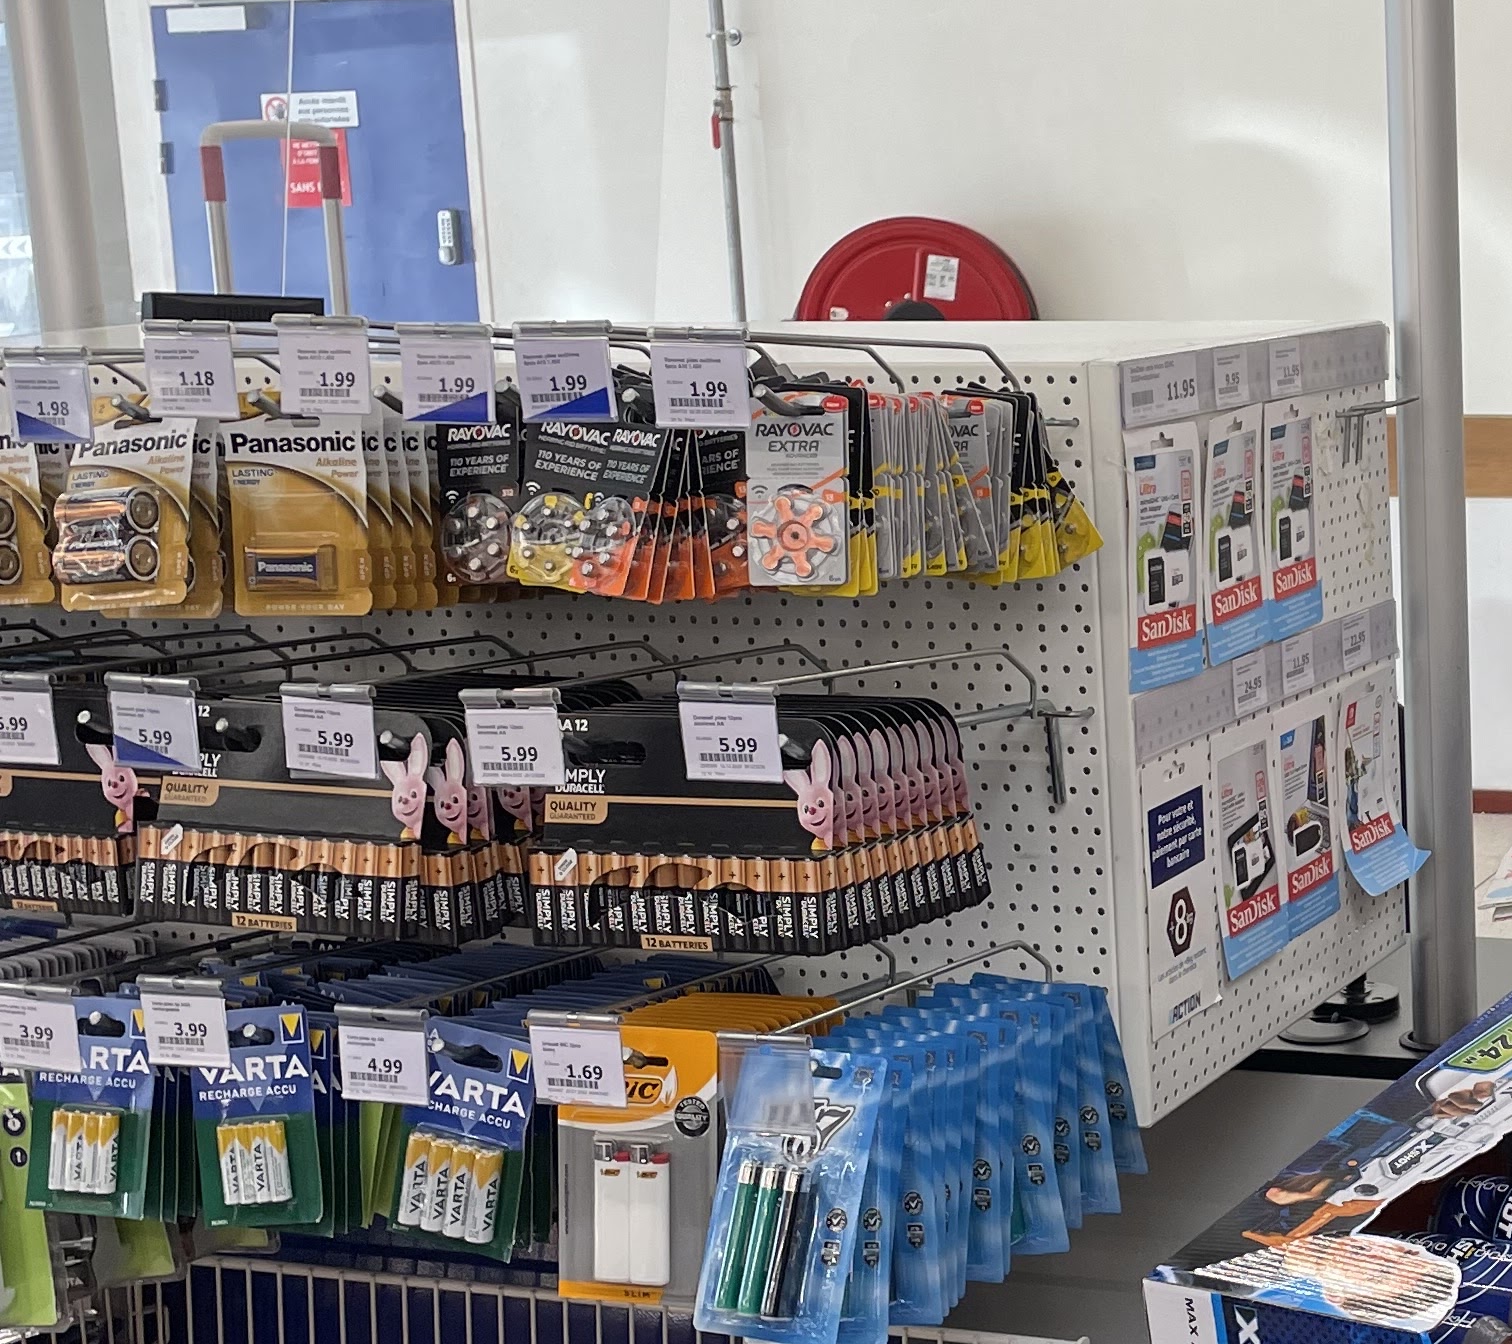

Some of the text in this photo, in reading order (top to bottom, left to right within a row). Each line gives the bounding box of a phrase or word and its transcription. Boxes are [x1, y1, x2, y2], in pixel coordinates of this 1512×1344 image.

[290, 181, 316, 193] SANS
[179, 371, 215, 386] 1.18
[1225, 371, 1240, 386] 9.95
[1283, 363, 1300, 378] 11.95
[320, 372, 356, 387] 1.99
[438, 377, 475, 392] 1.99
[549, 374, 588, 391] 1.99
[690, 381, 728, 397] 1.99
[1167, 378, 1196, 401] 11.95
[37, 401, 70, 416] 1.98
[447, 423, 511, 442] RAYOVAC
[541, 422, 611, 446] RAYOVAC
[612, 428, 661, 448] RAYOVAC
[756, 422, 834, 437] RAYOVAC
[78, 431, 189, 459] Panasonic
[230, 431, 357, 454] Panasonic
[768, 440, 820, 452] EXTRA
[315, 457, 357, 467] Alkaline
[465, 456, 492, 467] YEARS
[494, 453, 509, 465] OF
[555, 452, 586, 468] YEARS
[587, 459, 602, 471] OF
[618, 460, 639, 472] YEARS
[640, 462, 652, 473] OF
[71, 470, 109, 481] LASTING
[232, 468, 275, 479] LASTING
[331, 469, 359, 479] Power
[449, 464, 508, 477] EXPERIENCE
[534, 459, 599, 482] EXPERIENCE
[602, 468, 648, 485] EXPERIENCE
[257, 561, 314, 574] Panasonic
[1275, 562, 1314, 594] SanDisk
[1214, 583, 1259, 617] SanDisk
[1142, 611, 1193, 642] SanDisk
[1292, 652, 1310, 670] 11.95
[198, 705, 211, 718] 12
[574, 718, 589, 732] 12
[138, 728, 173, 746] 5.99
[317, 729, 354, 748] 5.99
[718, 737, 758, 753] 5.99
[501, 746, 538, 762] 5.99
[565, 768, 606, 784] MPLY
[166, 782, 209, 794] QUALITY
[555, 782, 605, 794] DURACELL
[550, 800, 597, 812] QUALITY
[549, 812, 596, 821] GUARANTEED
[1157, 811, 1172, 826] Pour
[1172, 804, 1186, 819] votre
[1156, 827, 1172, 842] notre
[1353, 816, 1392, 850] SanDisk
[1152, 826, 1203, 863] paiement par carte
[1166, 848, 1190, 869] bancaire
[167, 863, 177, 905] SIMPLY
[1291, 858, 1331, 895] SanDisk
[386, 880, 396, 923] SIMPLY
[542, 888, 552, 931] SIMPLY
[807, 896, 819, 940] SIMPLY
[1230, 893, 1277, 932] SanDisk
[236, 915, 294, 932] 12 BATTERIES
[645, 937, 709, 950] 12 BATTERIES
[1171, 990, 1202, 1025] ACTION
[19, 1024, 54, 1041] 3.99
[174, 1022, 207, 1038] 3.99
[81, 1044, 150, 1075] RTA
[367, 1058, 403, 1074] 4.99
[199, 1053, 310, 1085] VARTA
[566, 1064, 603, 1081] 1.69
[39, 1072, 137, 1089] RECHARGE ACCU
[199, 1084, 297, 1101] RECHARGE ACCU
[429, 1070, 526, 1119] VARTA
[680, 1097, 706, 1110] TESTED
[428, 1099, 511, 1129] CHARGE ACCU
[255, 1143, 266, 1193] VARTA
[432, 1167, 450, 1220] VARTA
[450, 1172, 466, 1225] VARTA
[482, 1177, 499, 1232] VARTA
[623, 1289, 651, 1298] SLIM
[1184, 1297, 1199, 1337] MAX
